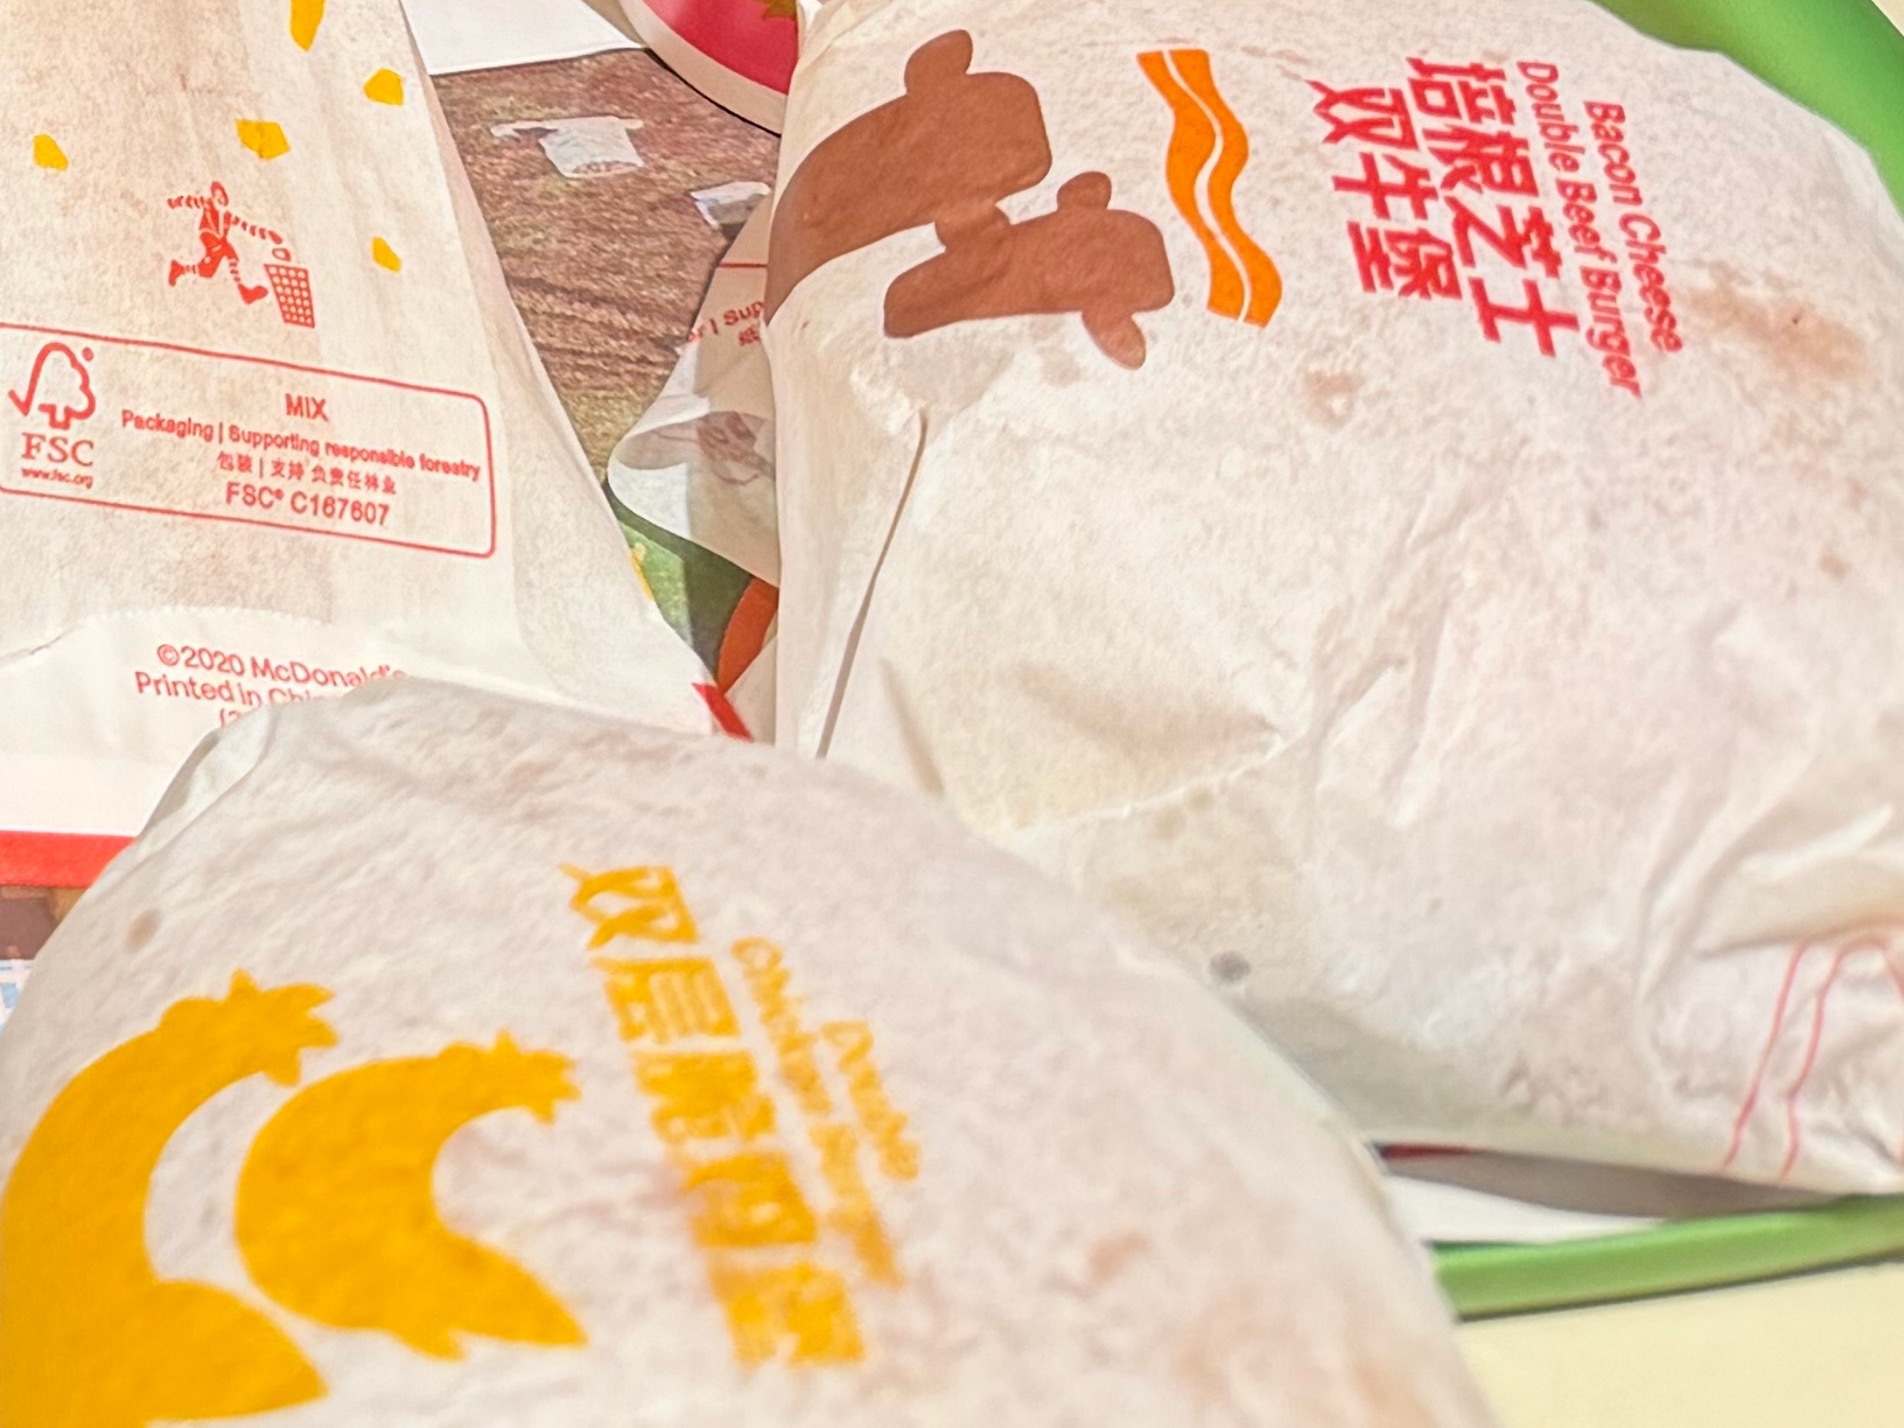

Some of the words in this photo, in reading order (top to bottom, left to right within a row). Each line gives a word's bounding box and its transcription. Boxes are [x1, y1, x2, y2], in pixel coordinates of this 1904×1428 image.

[1516, 59, 1586, 174] Double
[1304, 78, 1463, 300] 双牛堡
[1405, 56, 1580, 358] 培根芝士
[1555, 177, 1617, 265] Beef
[1583, 99, 1643, 207] Bacon
[1618, 211, 1684, 353] Cheese
[1579, 265, 1643, 400] Burger
[20, 431, 95, 467] FSC
[121, 409, 214, 443] Packaging
[228, 424, 321, 456] Supporting
[324, 441, 415, 470] responsible
[418, 452, 481, 482] forestry
[285, 392, 329, 422] MIX
[290, 490, 391, 526] C167607
[134, 670, 234, 703] Printed
[238, 682, 262, 710] in
